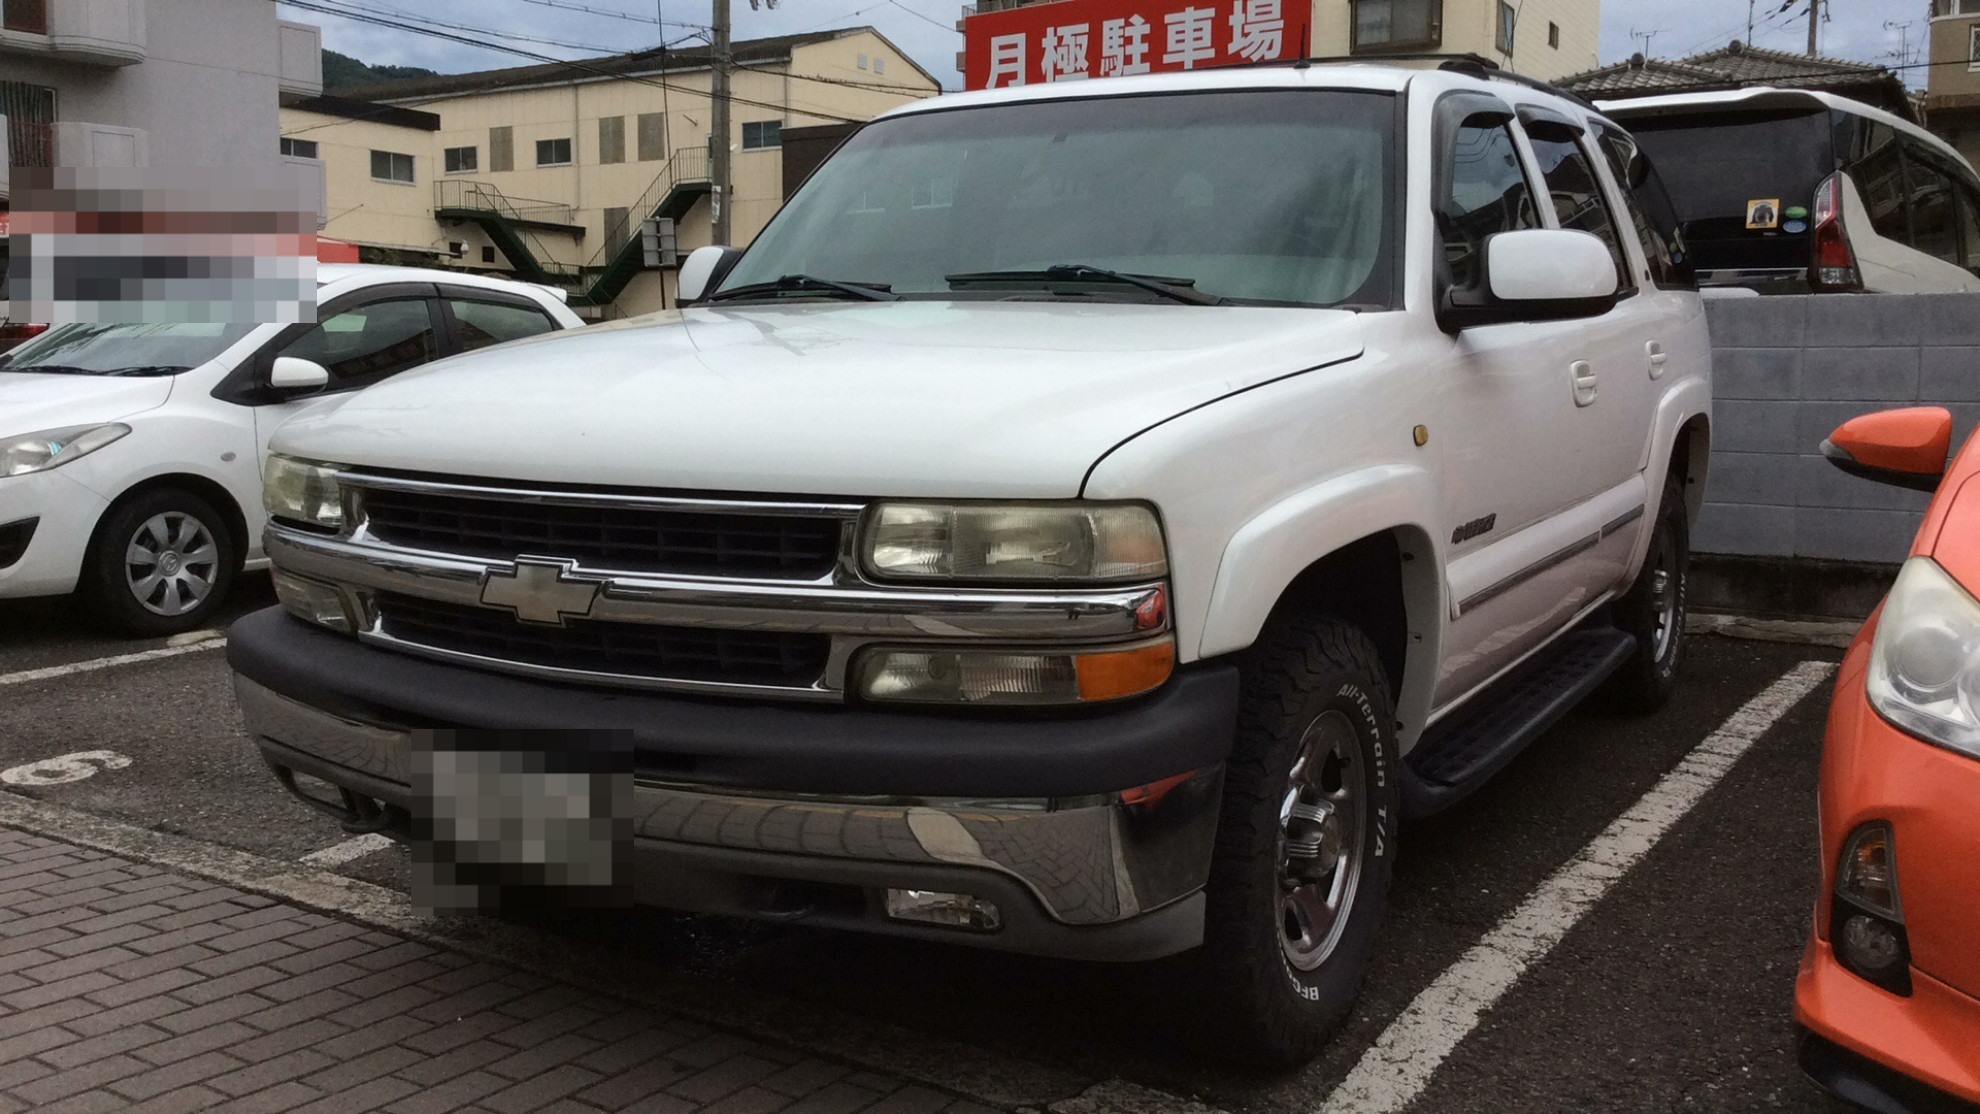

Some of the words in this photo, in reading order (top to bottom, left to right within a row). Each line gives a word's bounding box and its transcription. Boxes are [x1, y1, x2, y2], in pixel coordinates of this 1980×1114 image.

[986, 0, 1284, 89] 月極駐車場
[1336, 684, 1385, 787] All-Terrain
[1375, 804, 1387, 856] T/A
